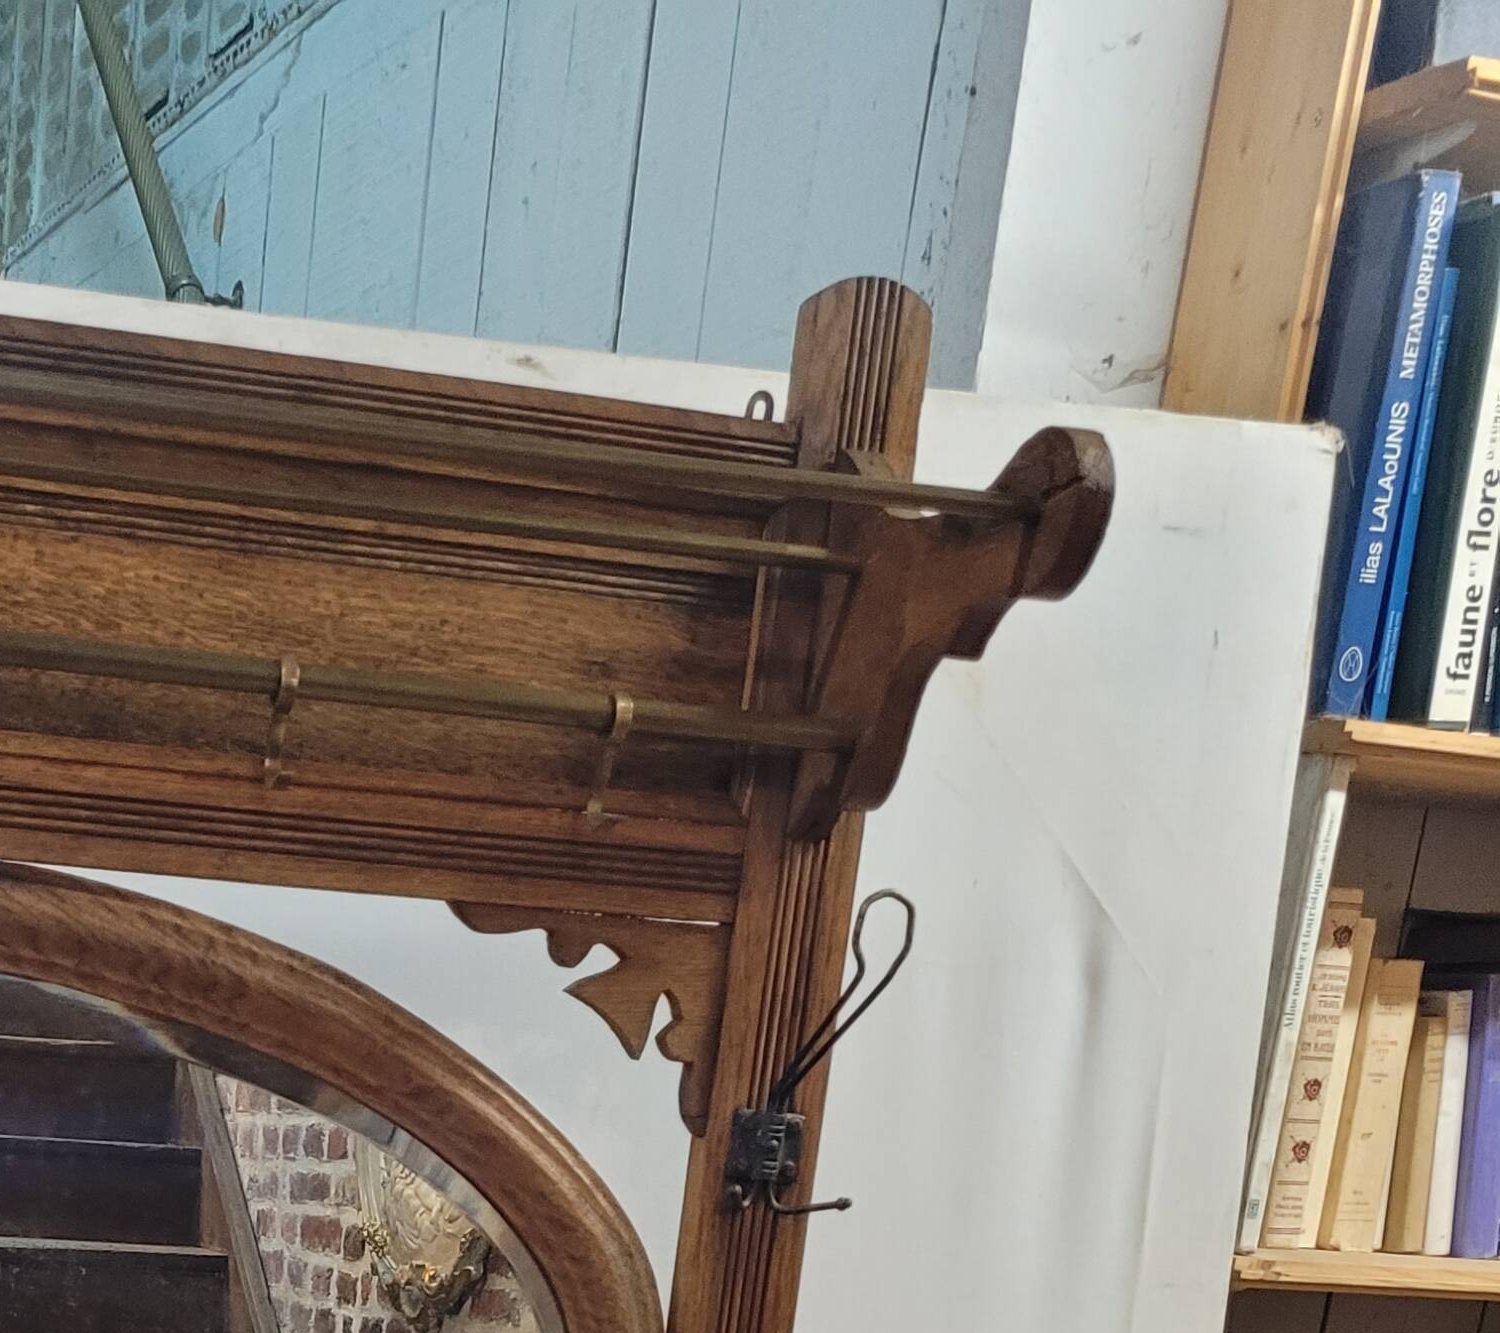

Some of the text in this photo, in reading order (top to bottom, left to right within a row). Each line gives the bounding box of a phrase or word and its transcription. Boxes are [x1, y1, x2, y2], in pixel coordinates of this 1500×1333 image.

[1399, 190, 1447, 380] METAMORPHOSES
[1369, 400, 1410, 532] LALAoUNIS
[1358, 541, 1383, 585] ilias
[1446, 584, 1484, 681] faune
[1466, 468, 1500, 552] flore
[1283, 1001, 1298, 1028] Atlas
[1293, 955, 1306, 999] routier
[1302, 868, 1324, 938] touristique
